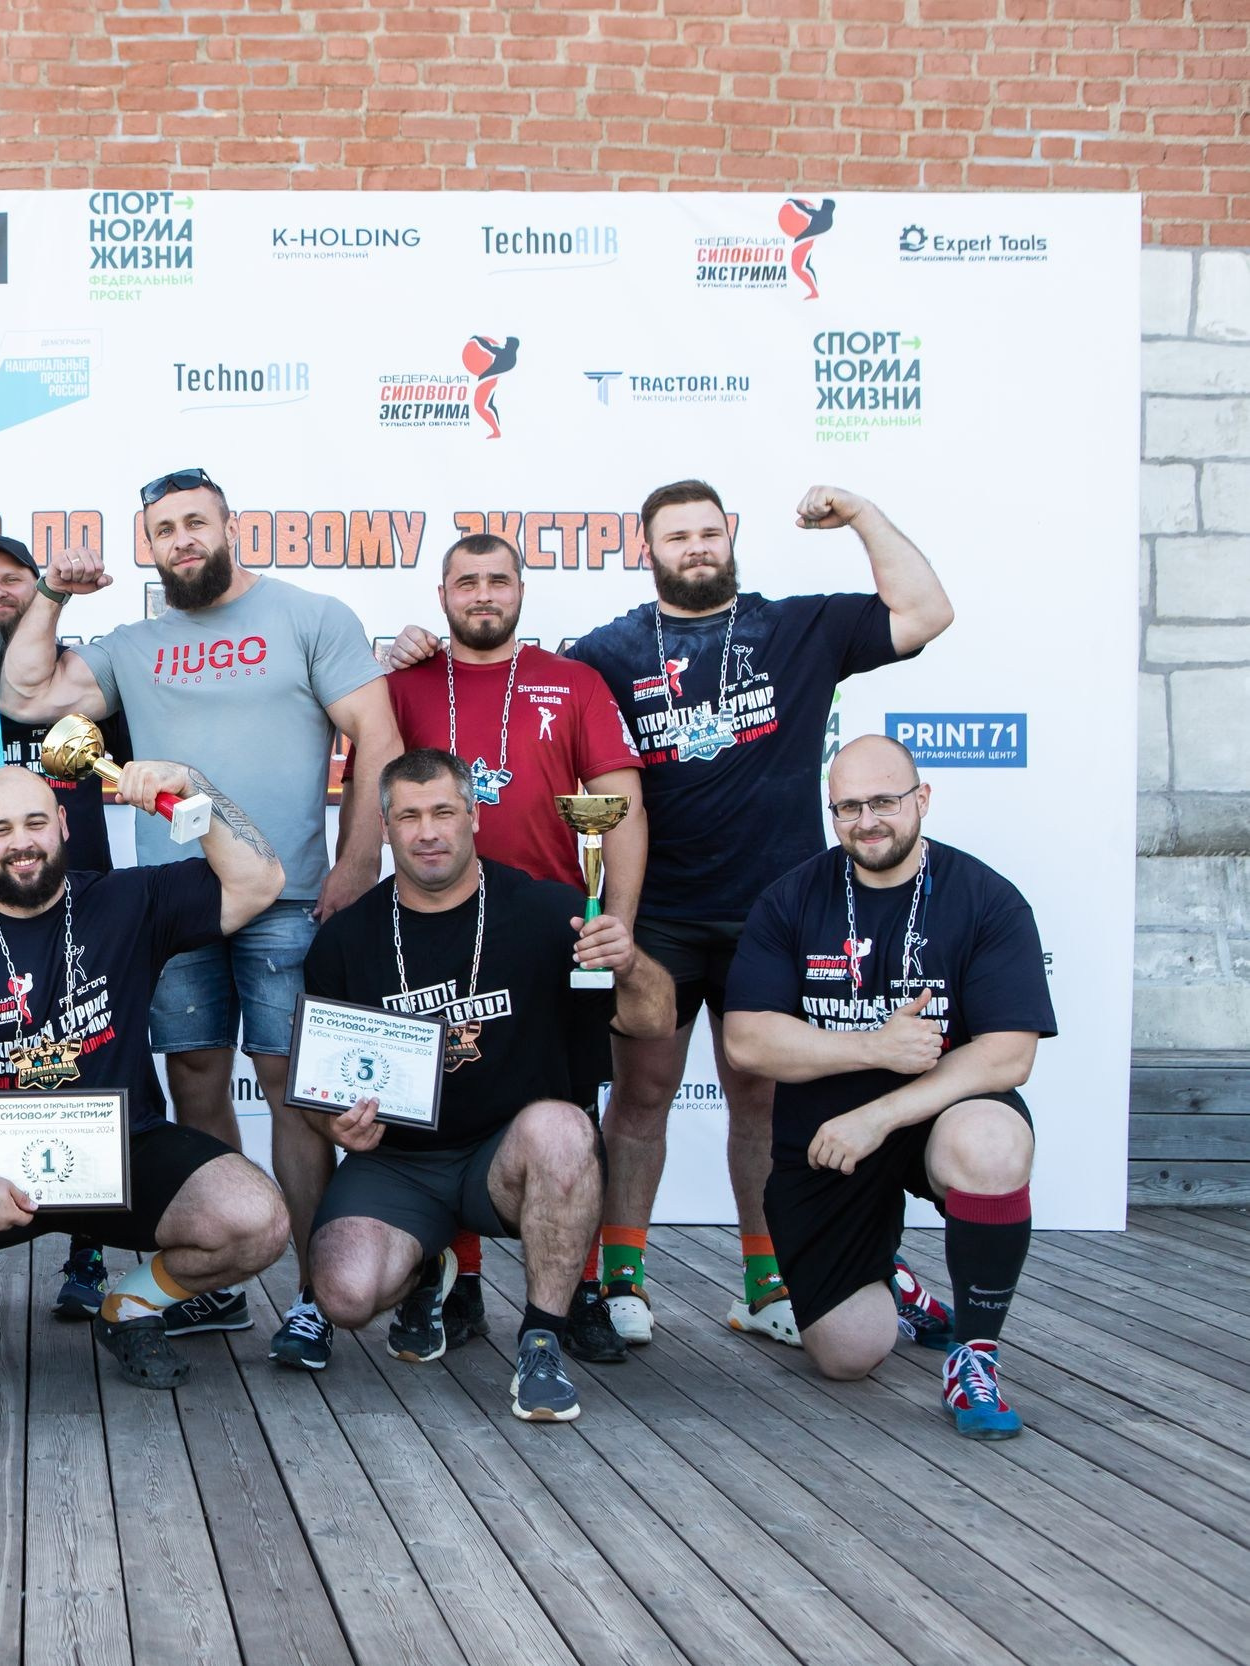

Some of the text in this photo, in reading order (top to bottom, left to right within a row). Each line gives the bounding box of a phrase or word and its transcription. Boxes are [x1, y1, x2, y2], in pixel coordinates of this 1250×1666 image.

[89, 191, 174, 215] СПОРТ
[90, 218, 192, 242] НОРМА
[273, 228, 421, 247] K-HOLDING
[481, 226, 618, 254] TechnoAIR
[695, 237, 785, 247] ФЕДЕРАЦИЯ
[934, 234, 1047, 255] Expert Tools
[90, 245, 192, 269] ЖИЗНИ
[273, 250, 369, 261] группа компаний
[696, 248, 784, 263] СИЛОВОГО
[89, 272, 193, 287] ФЕДЕРАЛЬНЫЙ
[696, 265, 787, 281] ЭКСТРИМА
[90, 290, 142, 301] ПРОЕКТ
[813, 331, 901, 355] СПОРТ
[5, 358, 88, 372] НАЦИОНАЛЬНЫЕ
[815, 359, 921, 382] НОРМА
[41, 371, 88, 384] ПРОЕКТЫ
[173, 362, 310, 392] TechnoAIR
[378, 375, 470, 384] ФЕДЕРАЦИЯ
[629, 376, 750, 392] TRACTORI.RU
[49, 384, 88, 397] РОССИИ
[380, 385, 468, 401] СИЛОВОГО
[816, 386, 921, 410] ЖИЗНИ
[632, 395, 747, 403] ТРАКТОРЫ РОССИИ ЗДЕСЬ
[379, 403, 470, 420] ЭКСТРИМА
[815, 414, 921, 428] ФЕДЕРАЛЬНЫЙ
[816, 431, 869, 442] ПРОЕКТ
[154, 636, 267, 676] HUGO
[154, 667, 266, 685] HUGO BOSS
[517, 685, 570, 694] Strongman
[530, 694, 562, 705] Russia
[897, 722, 1017, 748] PRINT 71
[988, 750, 1017, 760] ЦЕНТР
[453, 995, 505, 1021] GROUP
[309, 1016, 433, 1043] ПО СИЛОВОМУ ЭКСТРИМУ
[308, 1028, 331, 1039] Кубок
[414, 1047, 432, 1056] 2024
[358, 1057, 374, 1080] 3
[686, 1102, 723, 1110] РОССИИ
[0, 1111, 57, 1120] СИЛОВОМУ
[60, 1110, 113, 1119] ЭКСТРИМУ
[96, 1126, 115, 1134] 2024
[42, 1149, 55, 1173] 1
